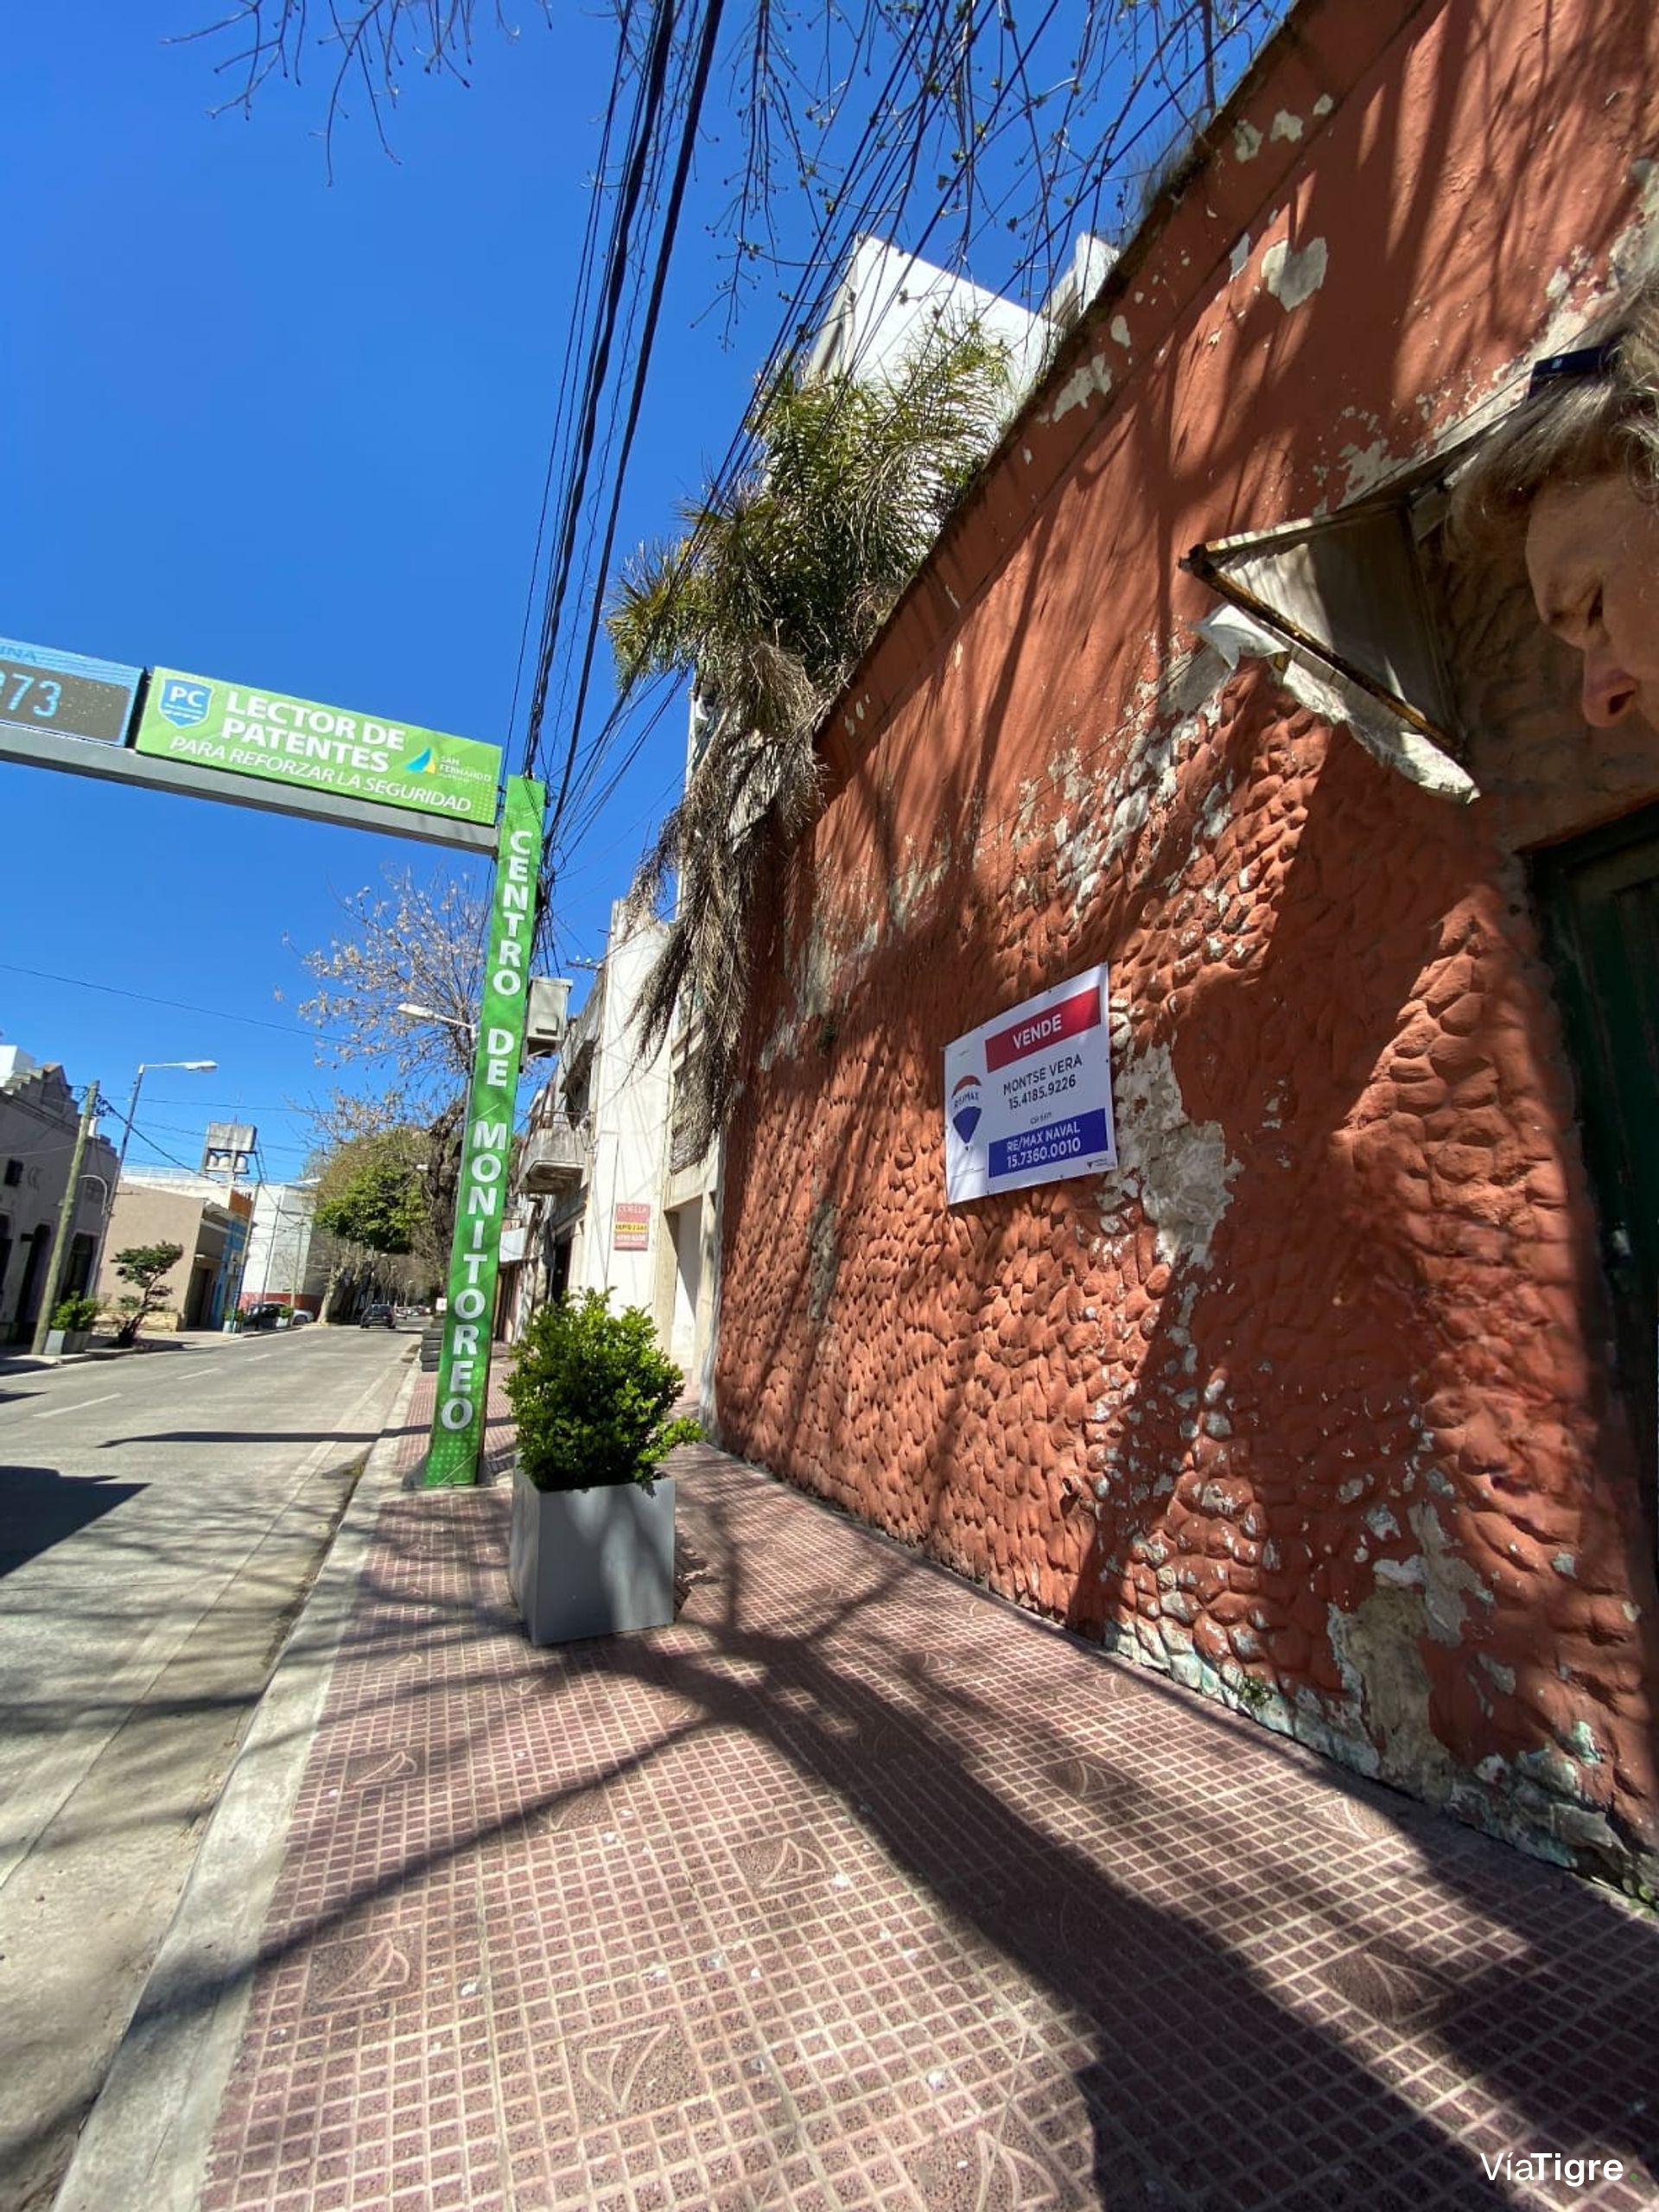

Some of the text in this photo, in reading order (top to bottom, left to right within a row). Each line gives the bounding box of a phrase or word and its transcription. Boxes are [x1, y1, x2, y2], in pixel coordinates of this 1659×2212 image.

[169, 685, 206, 708] PC
[226, 690, 406, 751] LECTOR DE
[220, 717, 389, 773] PATENTES
[169, 735, 472, 812] PARA REFORZAR LA SEGURIDAD
[1013, 1014, 1062, 1050] VENDE
[1003, 1053, 1083, 1096] MONTSE VERA
[1008, 1074, 1077, 1110] 15.4185.9226
[441, 830, 533, 1431] CENTRO DE MONITOREO
[1007, 1121, 1081, 1152] RE/MAX NAVAL
[1007, 1137, 1081, 1168] 15.7360.0010
